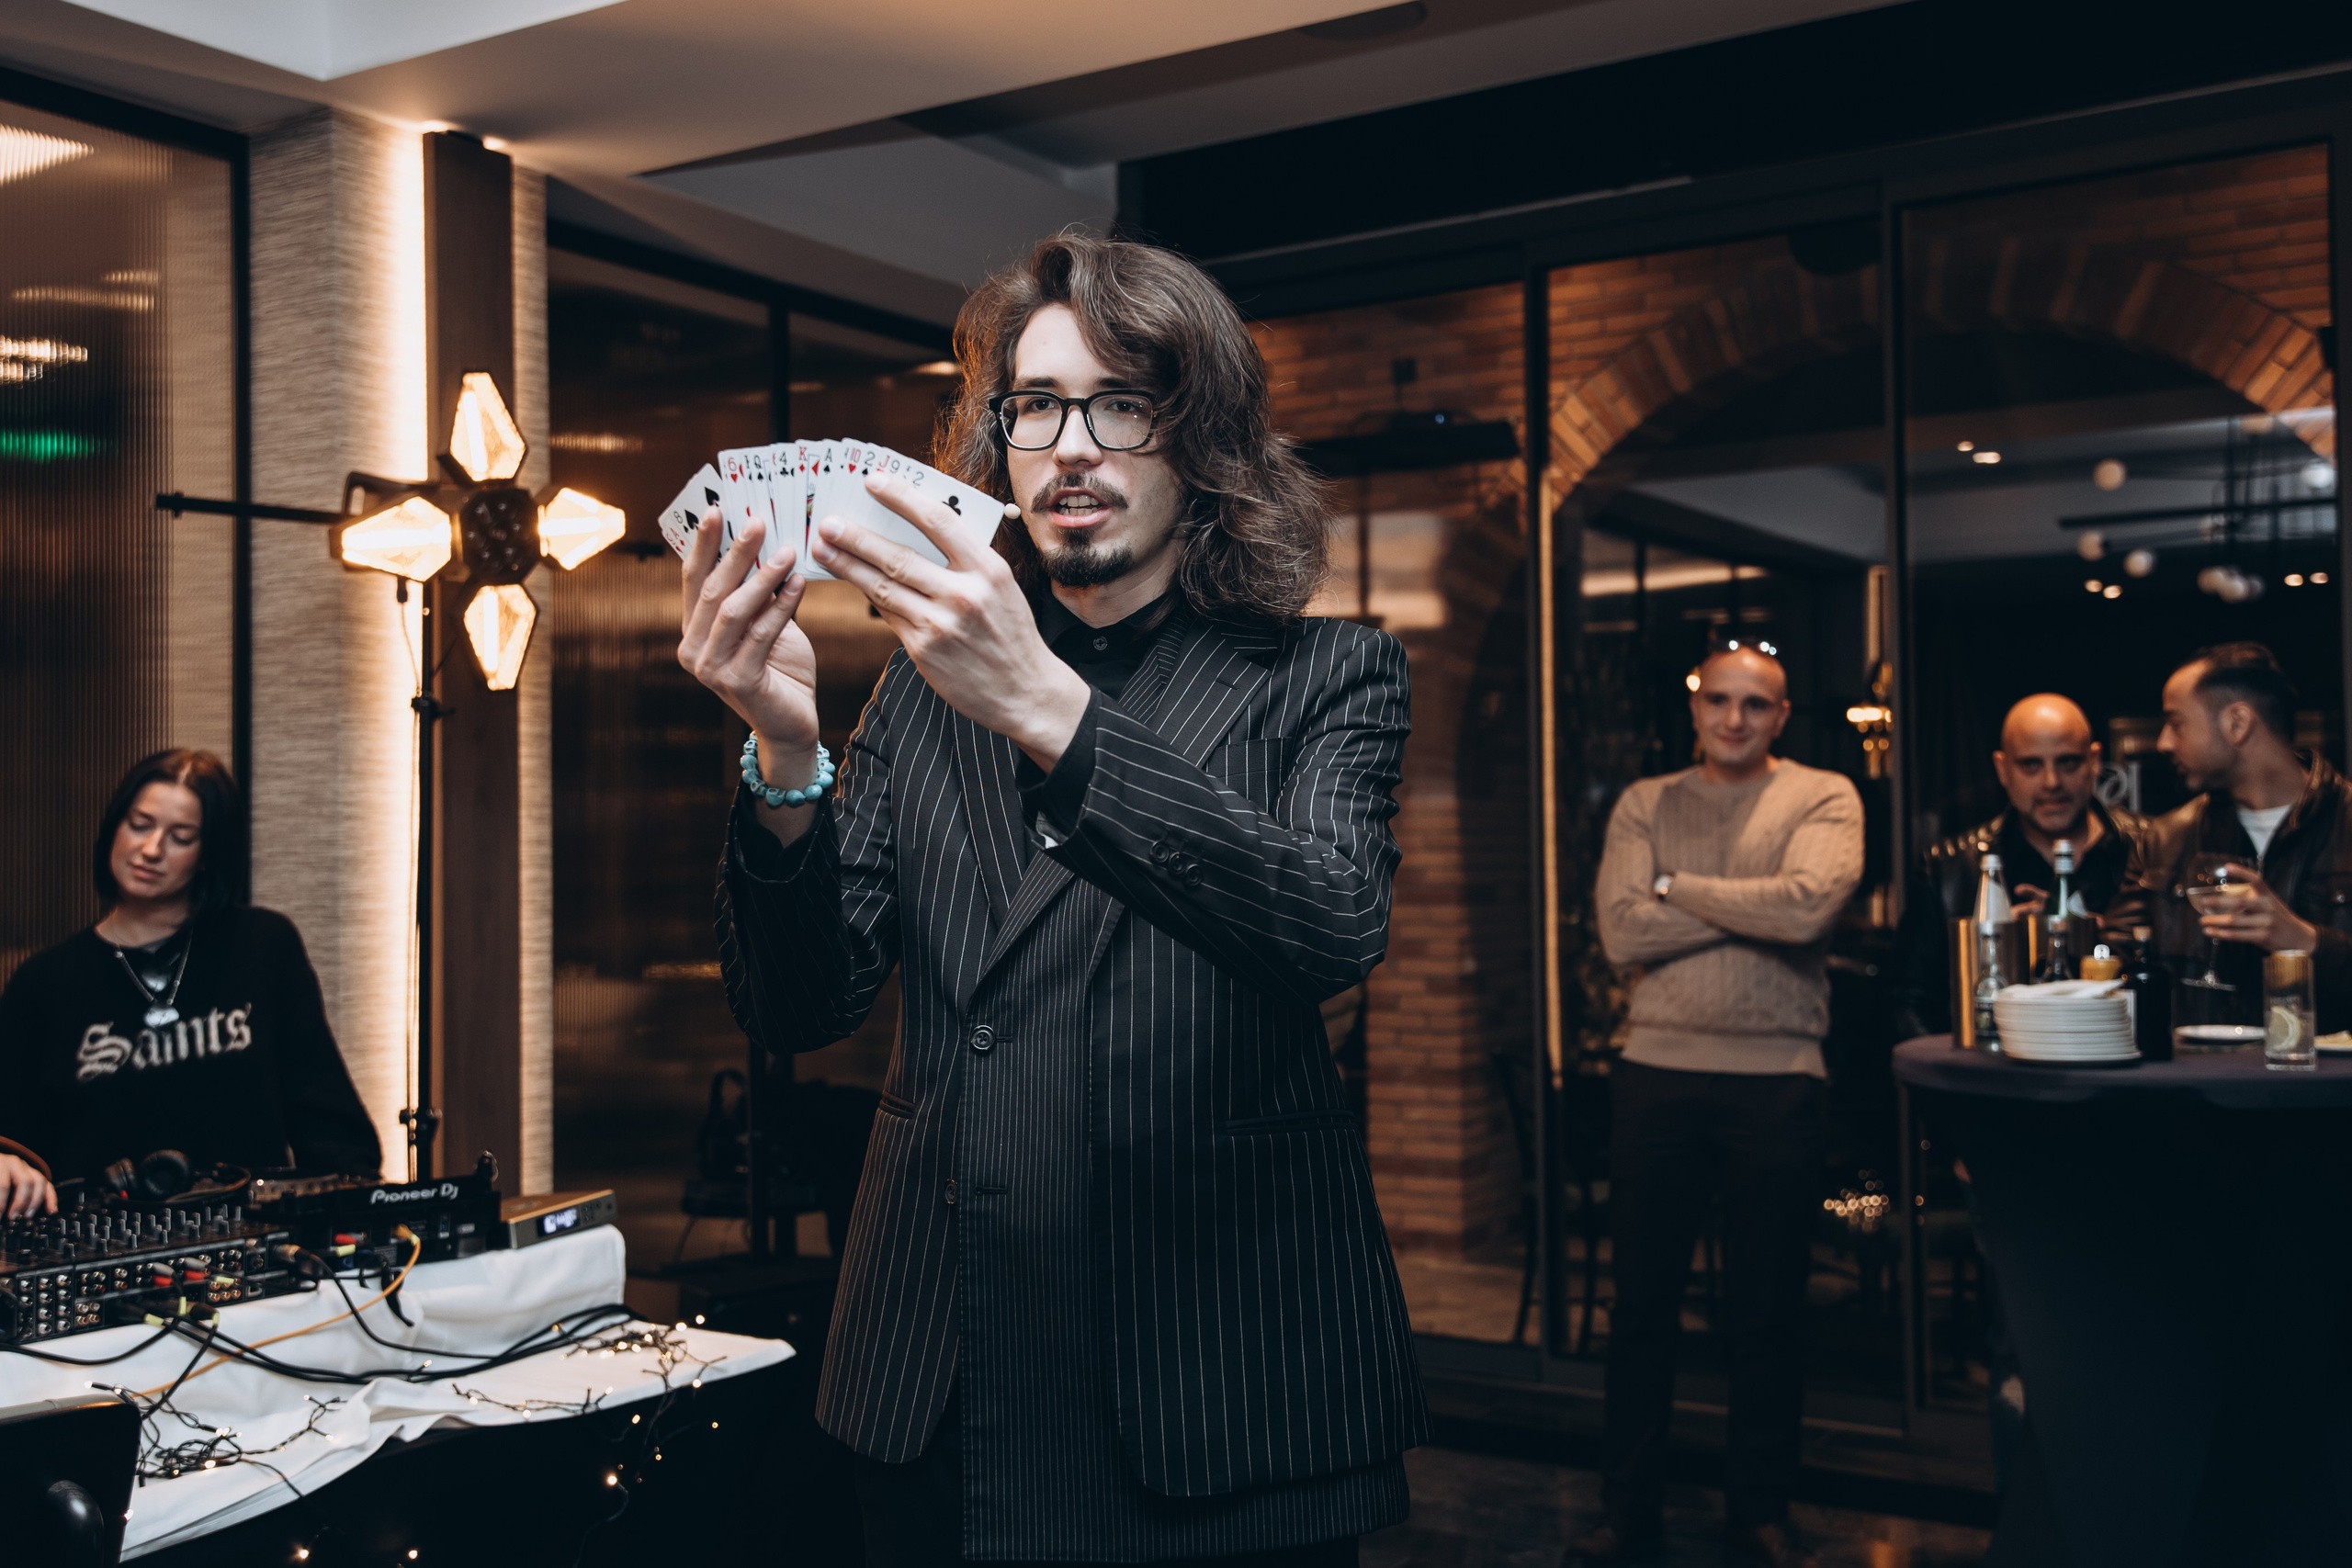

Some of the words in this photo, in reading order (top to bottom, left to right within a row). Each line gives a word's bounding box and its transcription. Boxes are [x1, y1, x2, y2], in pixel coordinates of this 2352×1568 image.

[779, 451, 787, 466] 4
[798, 446, 808, 462] K
[824, 446, 832, 463] A
[849, 447, 862, 464] 10
[865, 451, 876, 467] 2
[878, 455, 891, 468] J
[728, 457, 738, 472] 6
[753, 455, 763, 469] Q
[889, 459, 901, 474] 9
[912, 471, 925, 487] 2
[673, 511, 684, 525] 8
[670, 527, 680, 540] A
[76, 1002, 252, 1081] Saints
[370, 1189, 438, 1204] Pioneer
